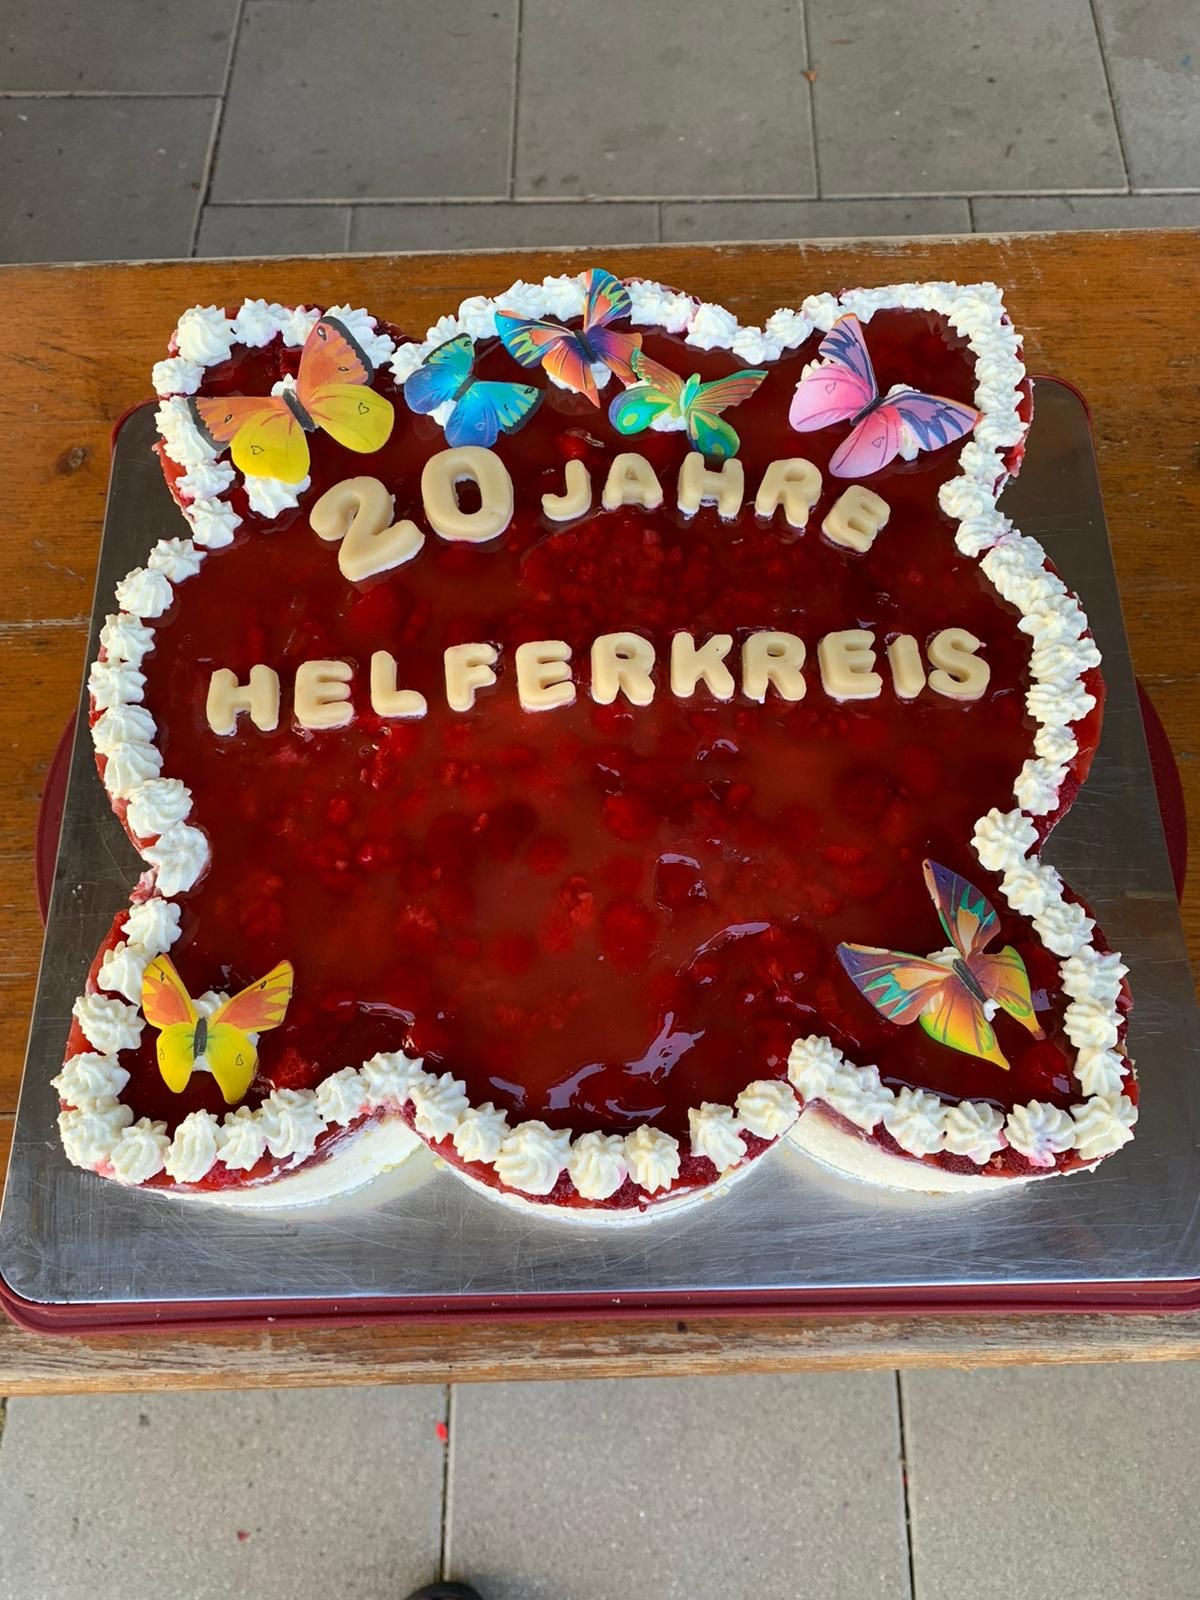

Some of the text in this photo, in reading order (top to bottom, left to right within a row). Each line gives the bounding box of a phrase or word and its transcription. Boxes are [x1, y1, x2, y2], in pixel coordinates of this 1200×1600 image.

[309, 446, 891, 582] 20 JAHRE
[206, 629, 990, 736] HELFERKREIS
